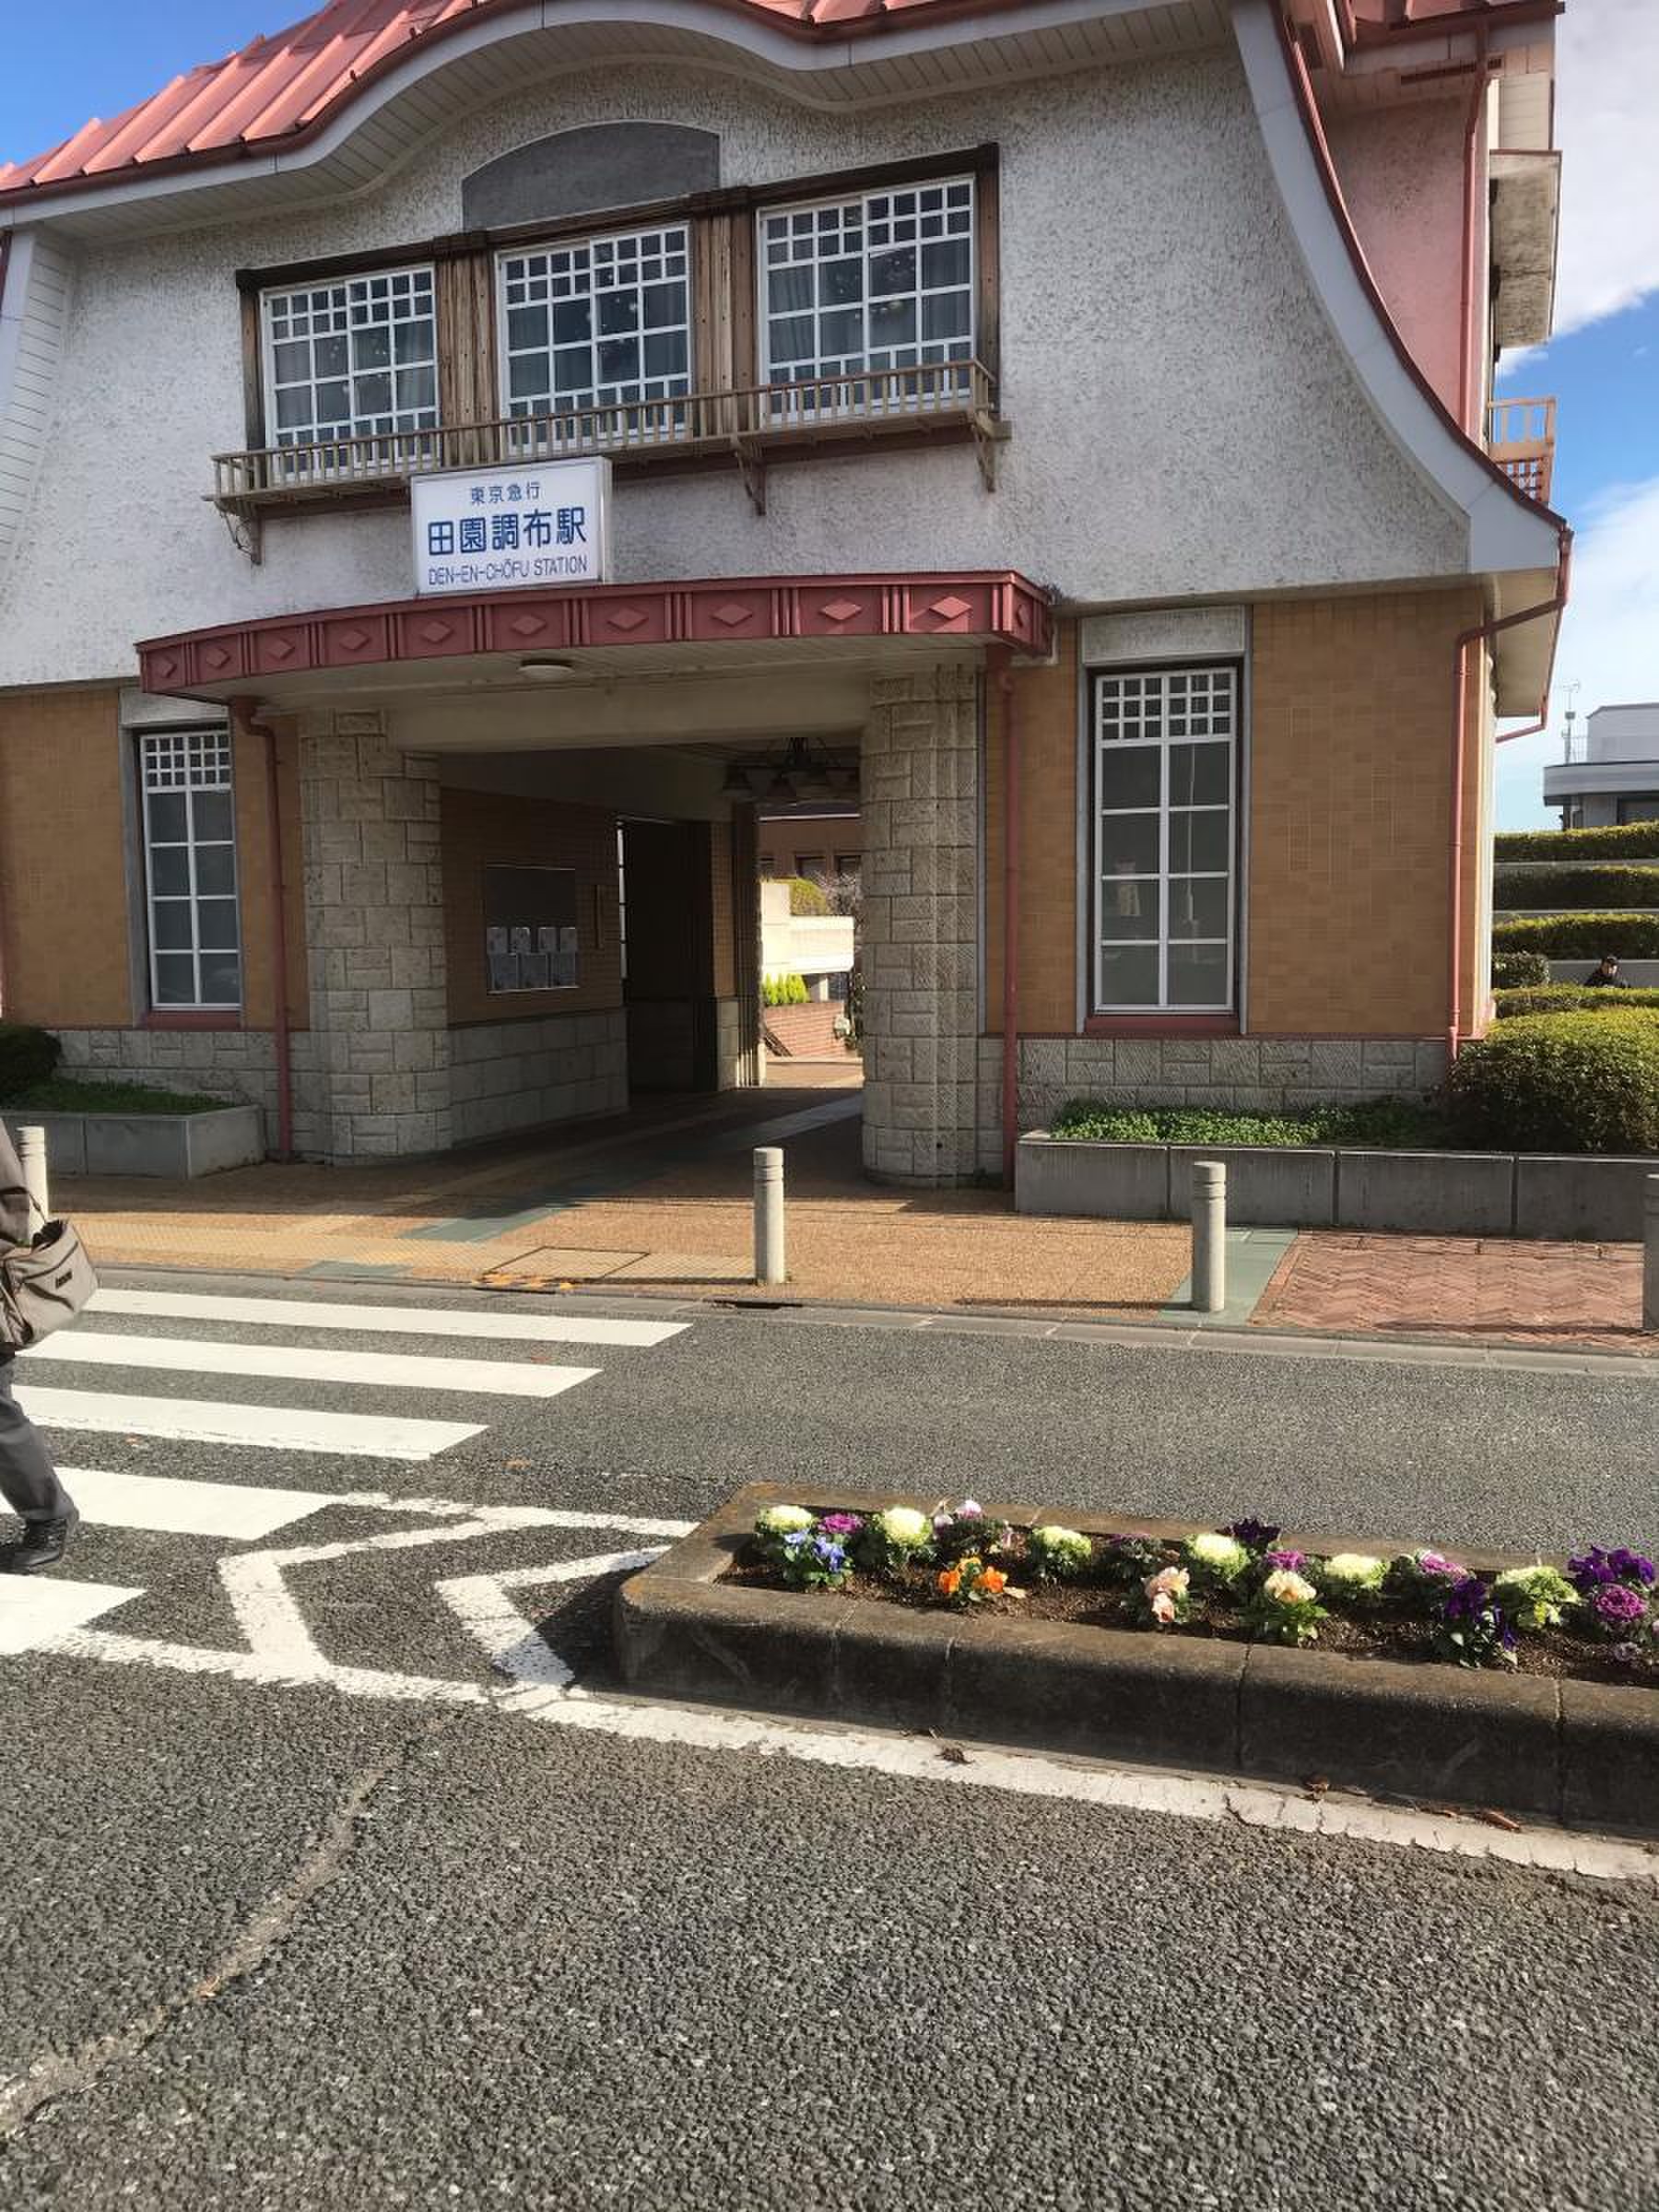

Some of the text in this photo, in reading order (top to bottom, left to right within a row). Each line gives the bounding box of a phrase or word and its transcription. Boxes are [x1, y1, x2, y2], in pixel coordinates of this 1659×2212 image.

[471, 481, 541, 505] 東京急行
[428, 506, 587, 556] 田園調布駅
[534, 555, 588, 577] STATION
